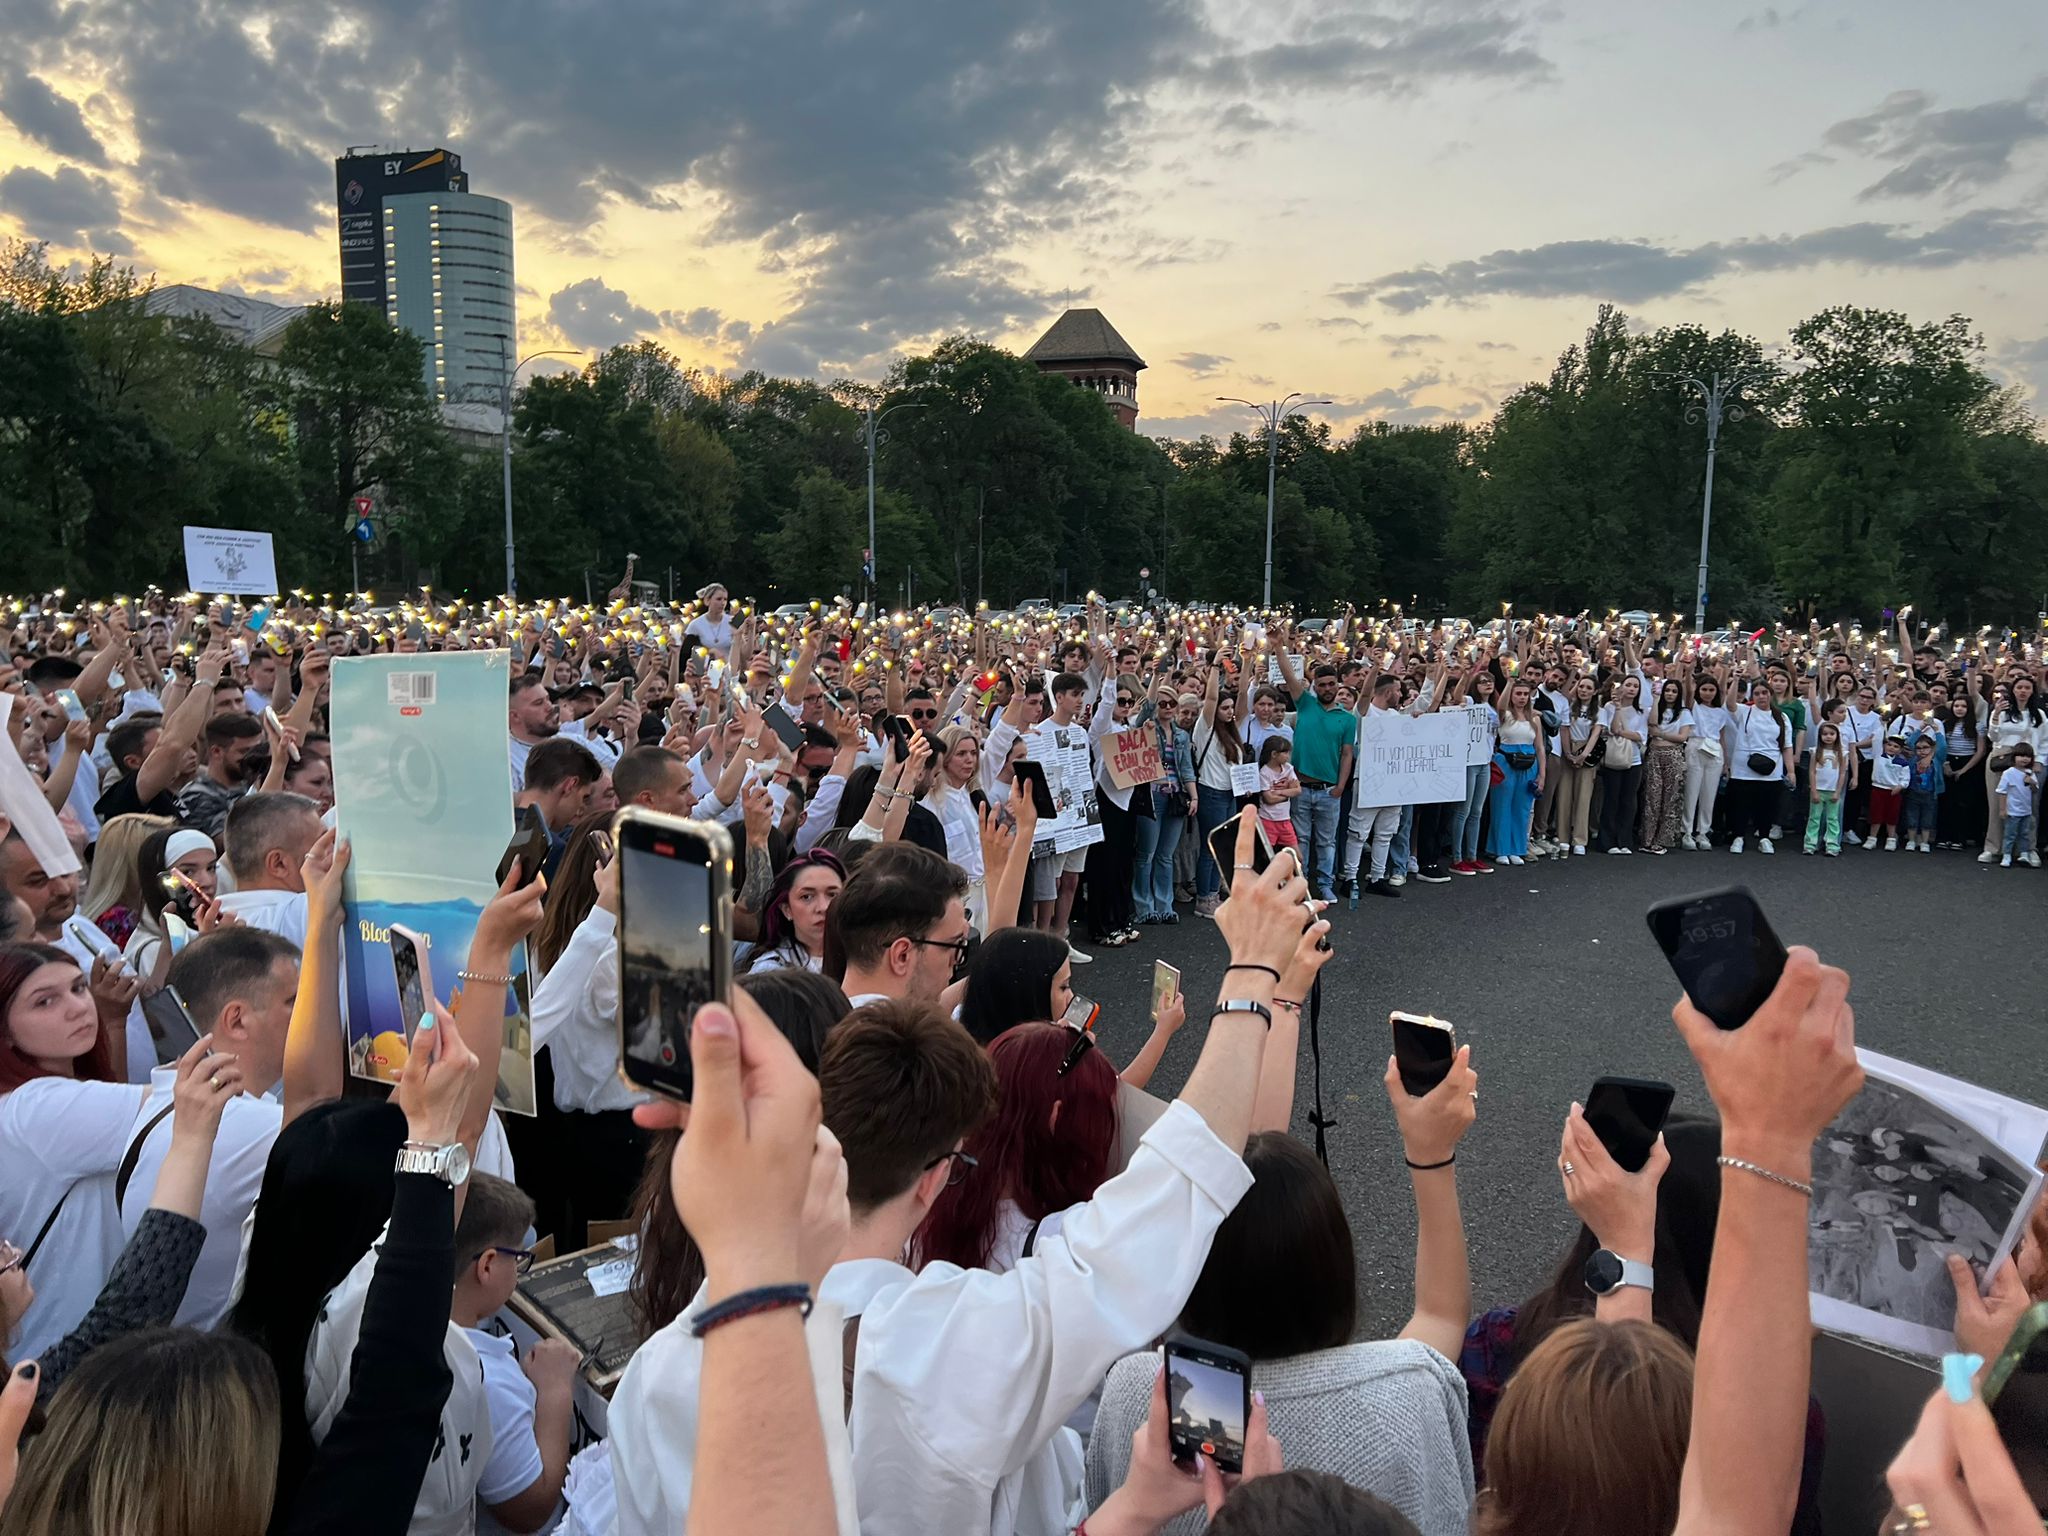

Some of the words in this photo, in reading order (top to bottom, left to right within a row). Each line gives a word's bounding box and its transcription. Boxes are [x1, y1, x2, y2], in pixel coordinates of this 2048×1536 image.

[384, 160, 402, 176] EY
[1470, 727, 1482, 743] CU
[1389, 745, 1405, 760] VOM
[1406, 744, 1426, 760] DUCE
[1429, 743, 1453, 758] VISUL
[1386, 760, 1400, 775] MAI
[1404, 758, 1437, 773] DEPARTE
[359, 919, 391, 944] Bloc
[1683, 920, 1736, 944] 19:57
